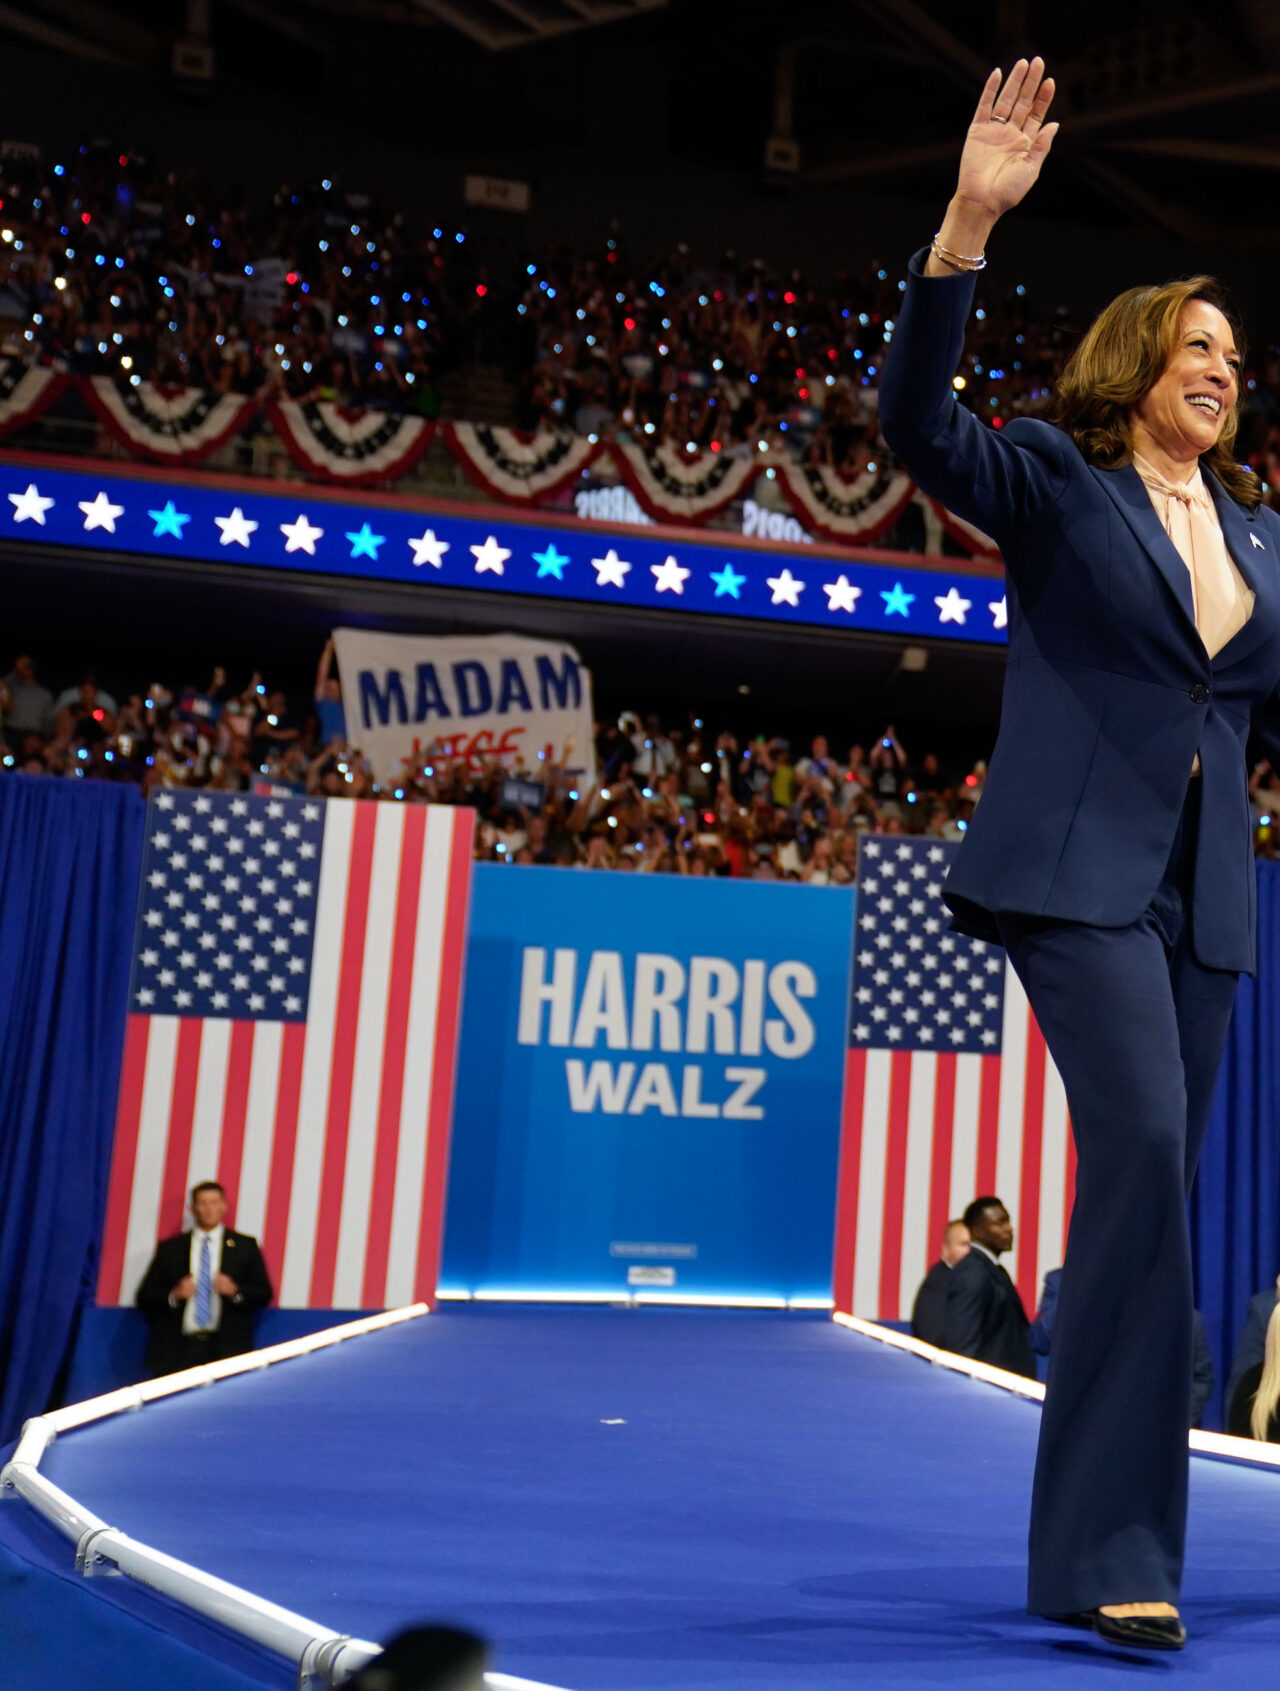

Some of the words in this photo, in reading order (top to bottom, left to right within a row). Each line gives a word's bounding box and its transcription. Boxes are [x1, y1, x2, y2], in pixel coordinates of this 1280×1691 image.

[358, 653, 582, 730] MADAM
[517, 946, 817, 1060] HARRIS
[565, 1058, 767, 1121] WALZ
